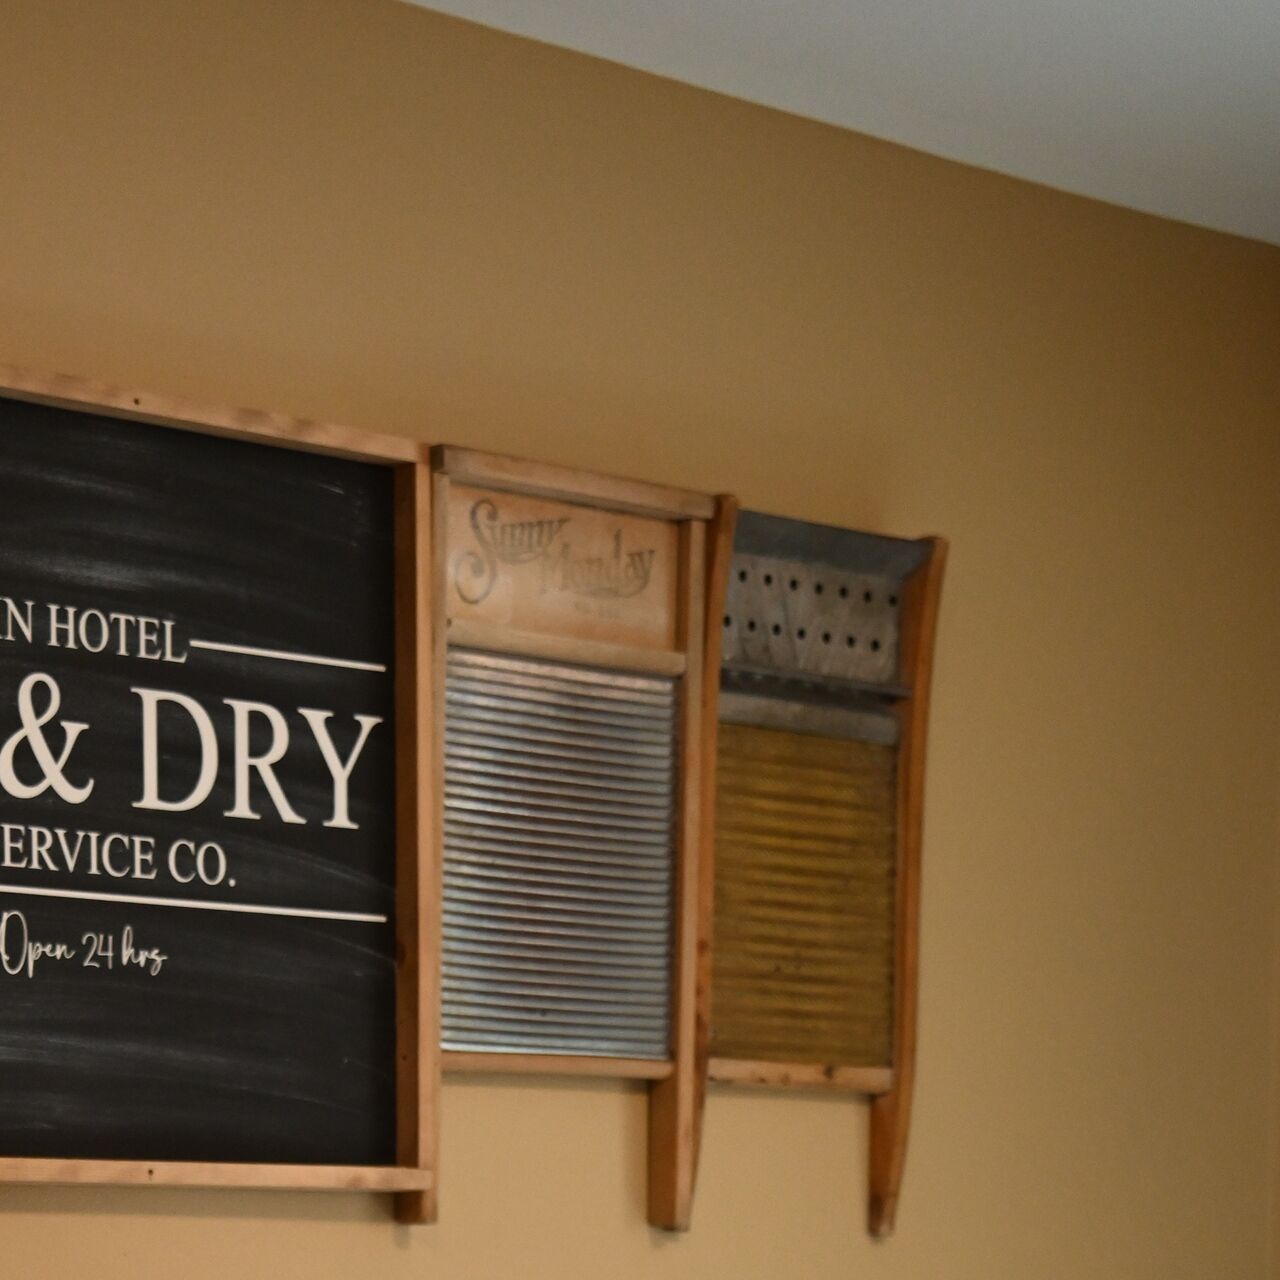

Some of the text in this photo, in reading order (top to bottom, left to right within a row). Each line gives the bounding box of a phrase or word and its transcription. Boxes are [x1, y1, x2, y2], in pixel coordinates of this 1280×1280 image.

[46, 602, 188, 664] HOTEL
[130, 686, 384, 830] DRY
[167, 838, 237, 888] CO.
[81, 933, 115, 970] 24
[121, 926, 168, 976] hrs
